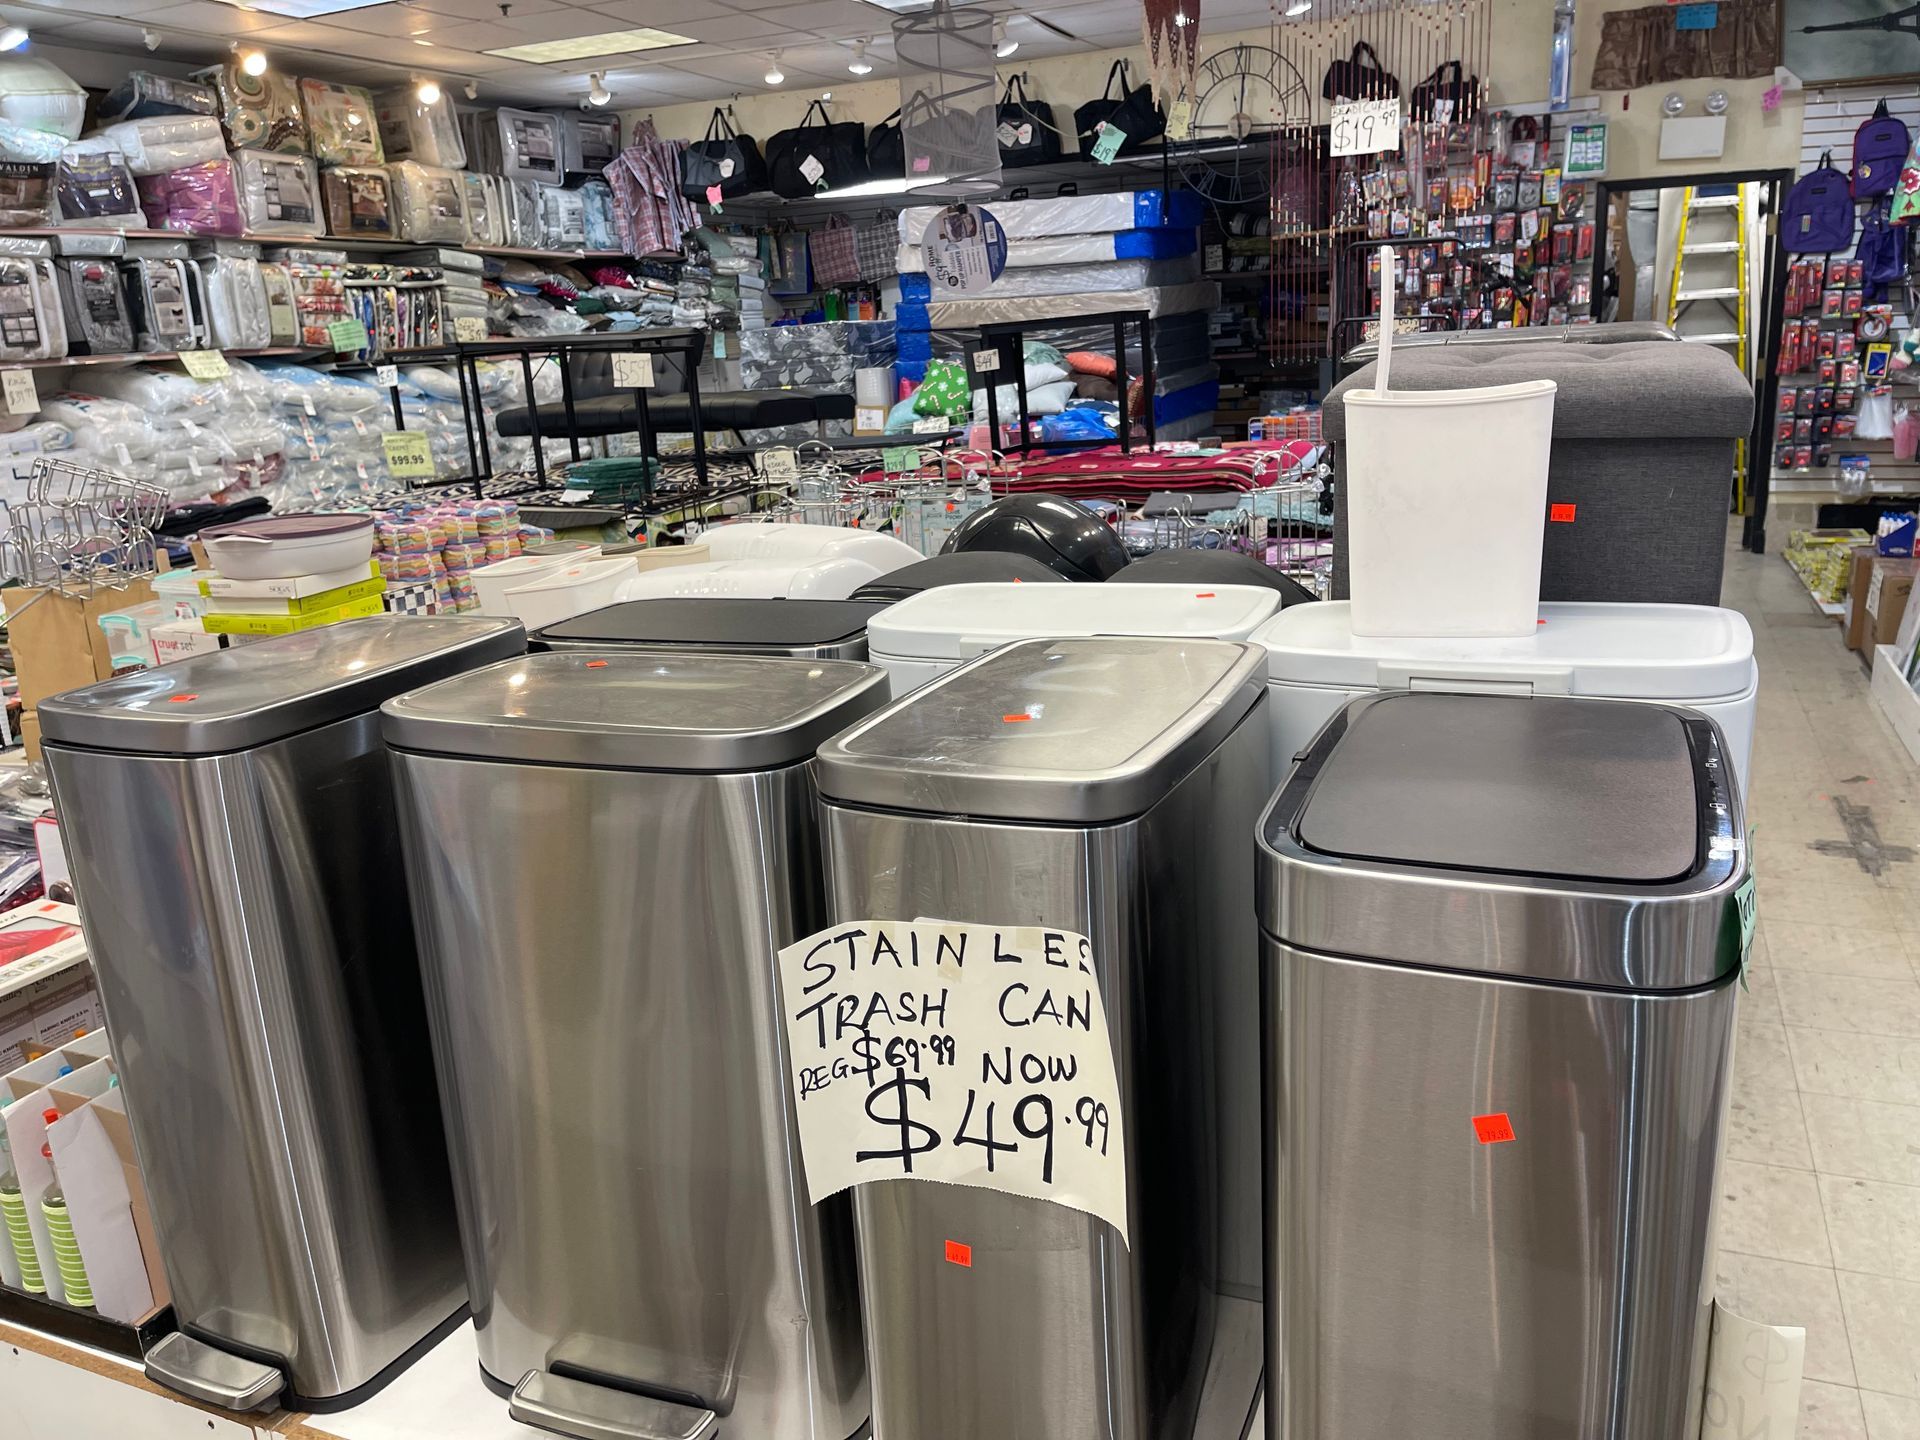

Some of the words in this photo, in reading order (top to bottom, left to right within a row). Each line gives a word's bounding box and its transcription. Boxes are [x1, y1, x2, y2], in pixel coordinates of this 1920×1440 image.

[1335, 109, 1397, 152] $19.99
[391, 454, 425, 466] $99.99
[60, 1014, 76, 1025] KNIFE
[796, 988, 949, 1049] TRASH
[999, 982, 1091, 1032] CAN
[851, 1029, 956, 1088] $69.99
[982, 1047, 1078, 1086] NOW
[856, 1067, 1110, 1184] $49.99
